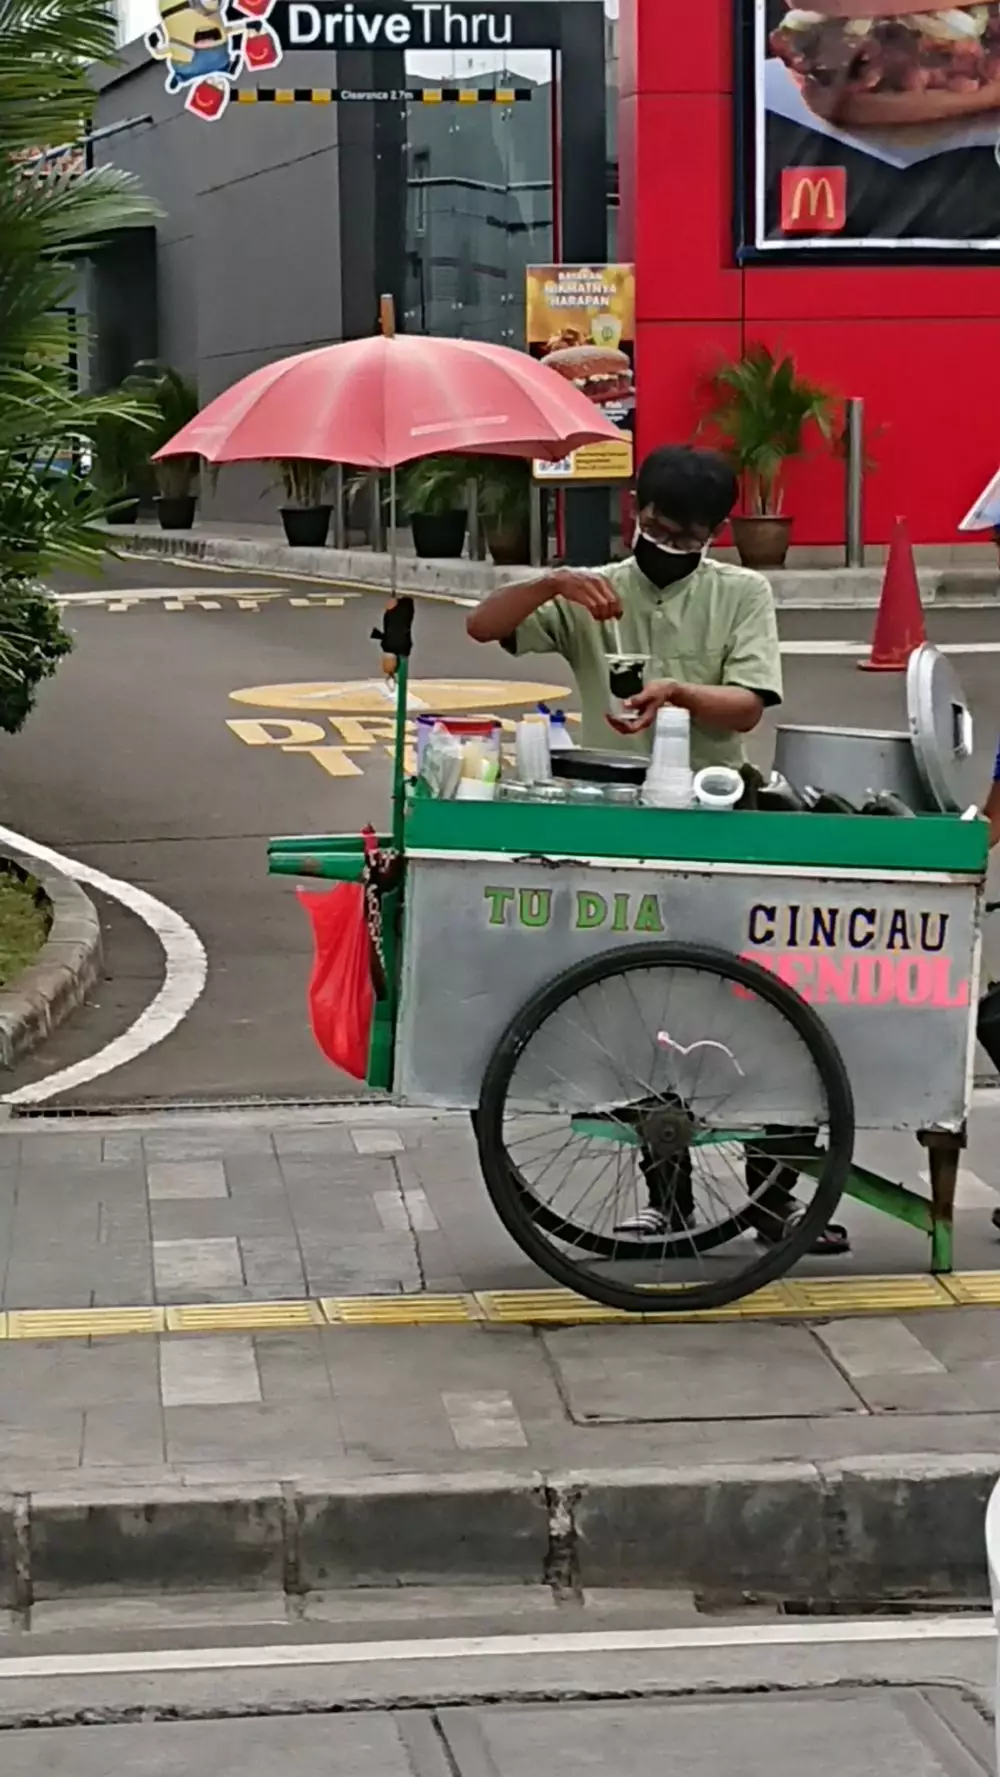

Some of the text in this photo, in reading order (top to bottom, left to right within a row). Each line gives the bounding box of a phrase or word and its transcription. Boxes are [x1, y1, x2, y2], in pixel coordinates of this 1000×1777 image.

[340, 89, 389, 100] Clearance
[551, 295, 609, 306] HARAPAN
[484, 886, 665, 932] TU DIA
[748, 904, 949, 951] CINCAU
